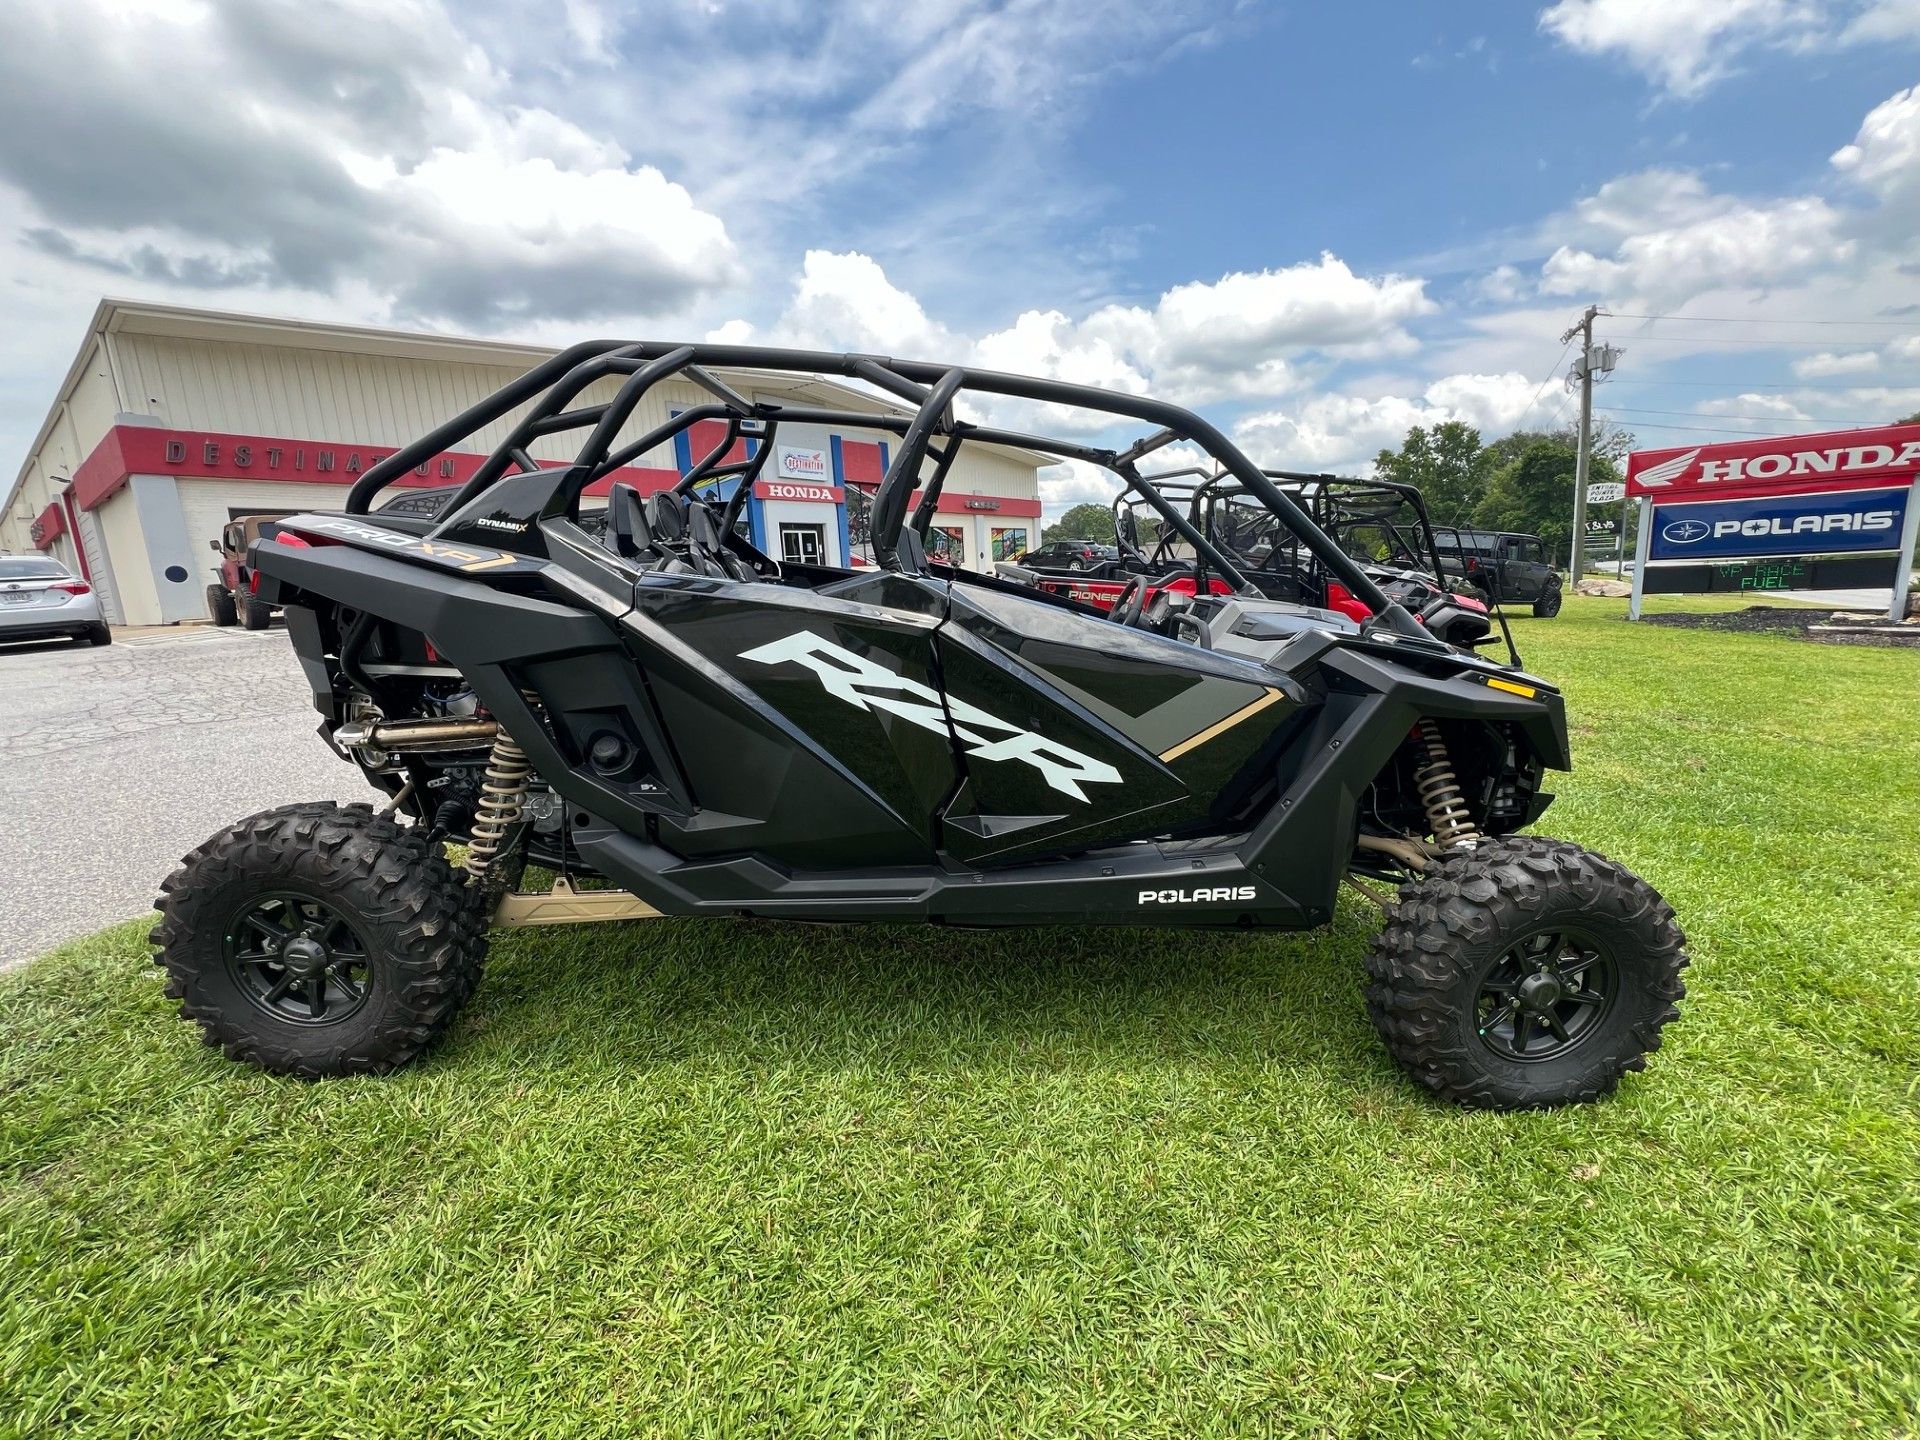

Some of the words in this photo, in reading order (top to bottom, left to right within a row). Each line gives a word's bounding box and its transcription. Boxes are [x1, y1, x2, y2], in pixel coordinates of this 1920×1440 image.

[165, 439, 455, 478] DESTINAON
[1697, 442, 1920, 483] HONDA
[767, 484, 834, 500] HONDA
[477, 517, 530, 533] DYNAMIX
[1713, 511, 1894, 538] POLARIS
[314, 522, 421, 547] PRO
[405, 542, 482, 562] XP
[1755, 564, 1805, 577] RACE
[1741, 576, 1790, 589] FUEL
[736, 629, 1124, 805] RZR
[1138, 886, 1257, 905] POLARIS
